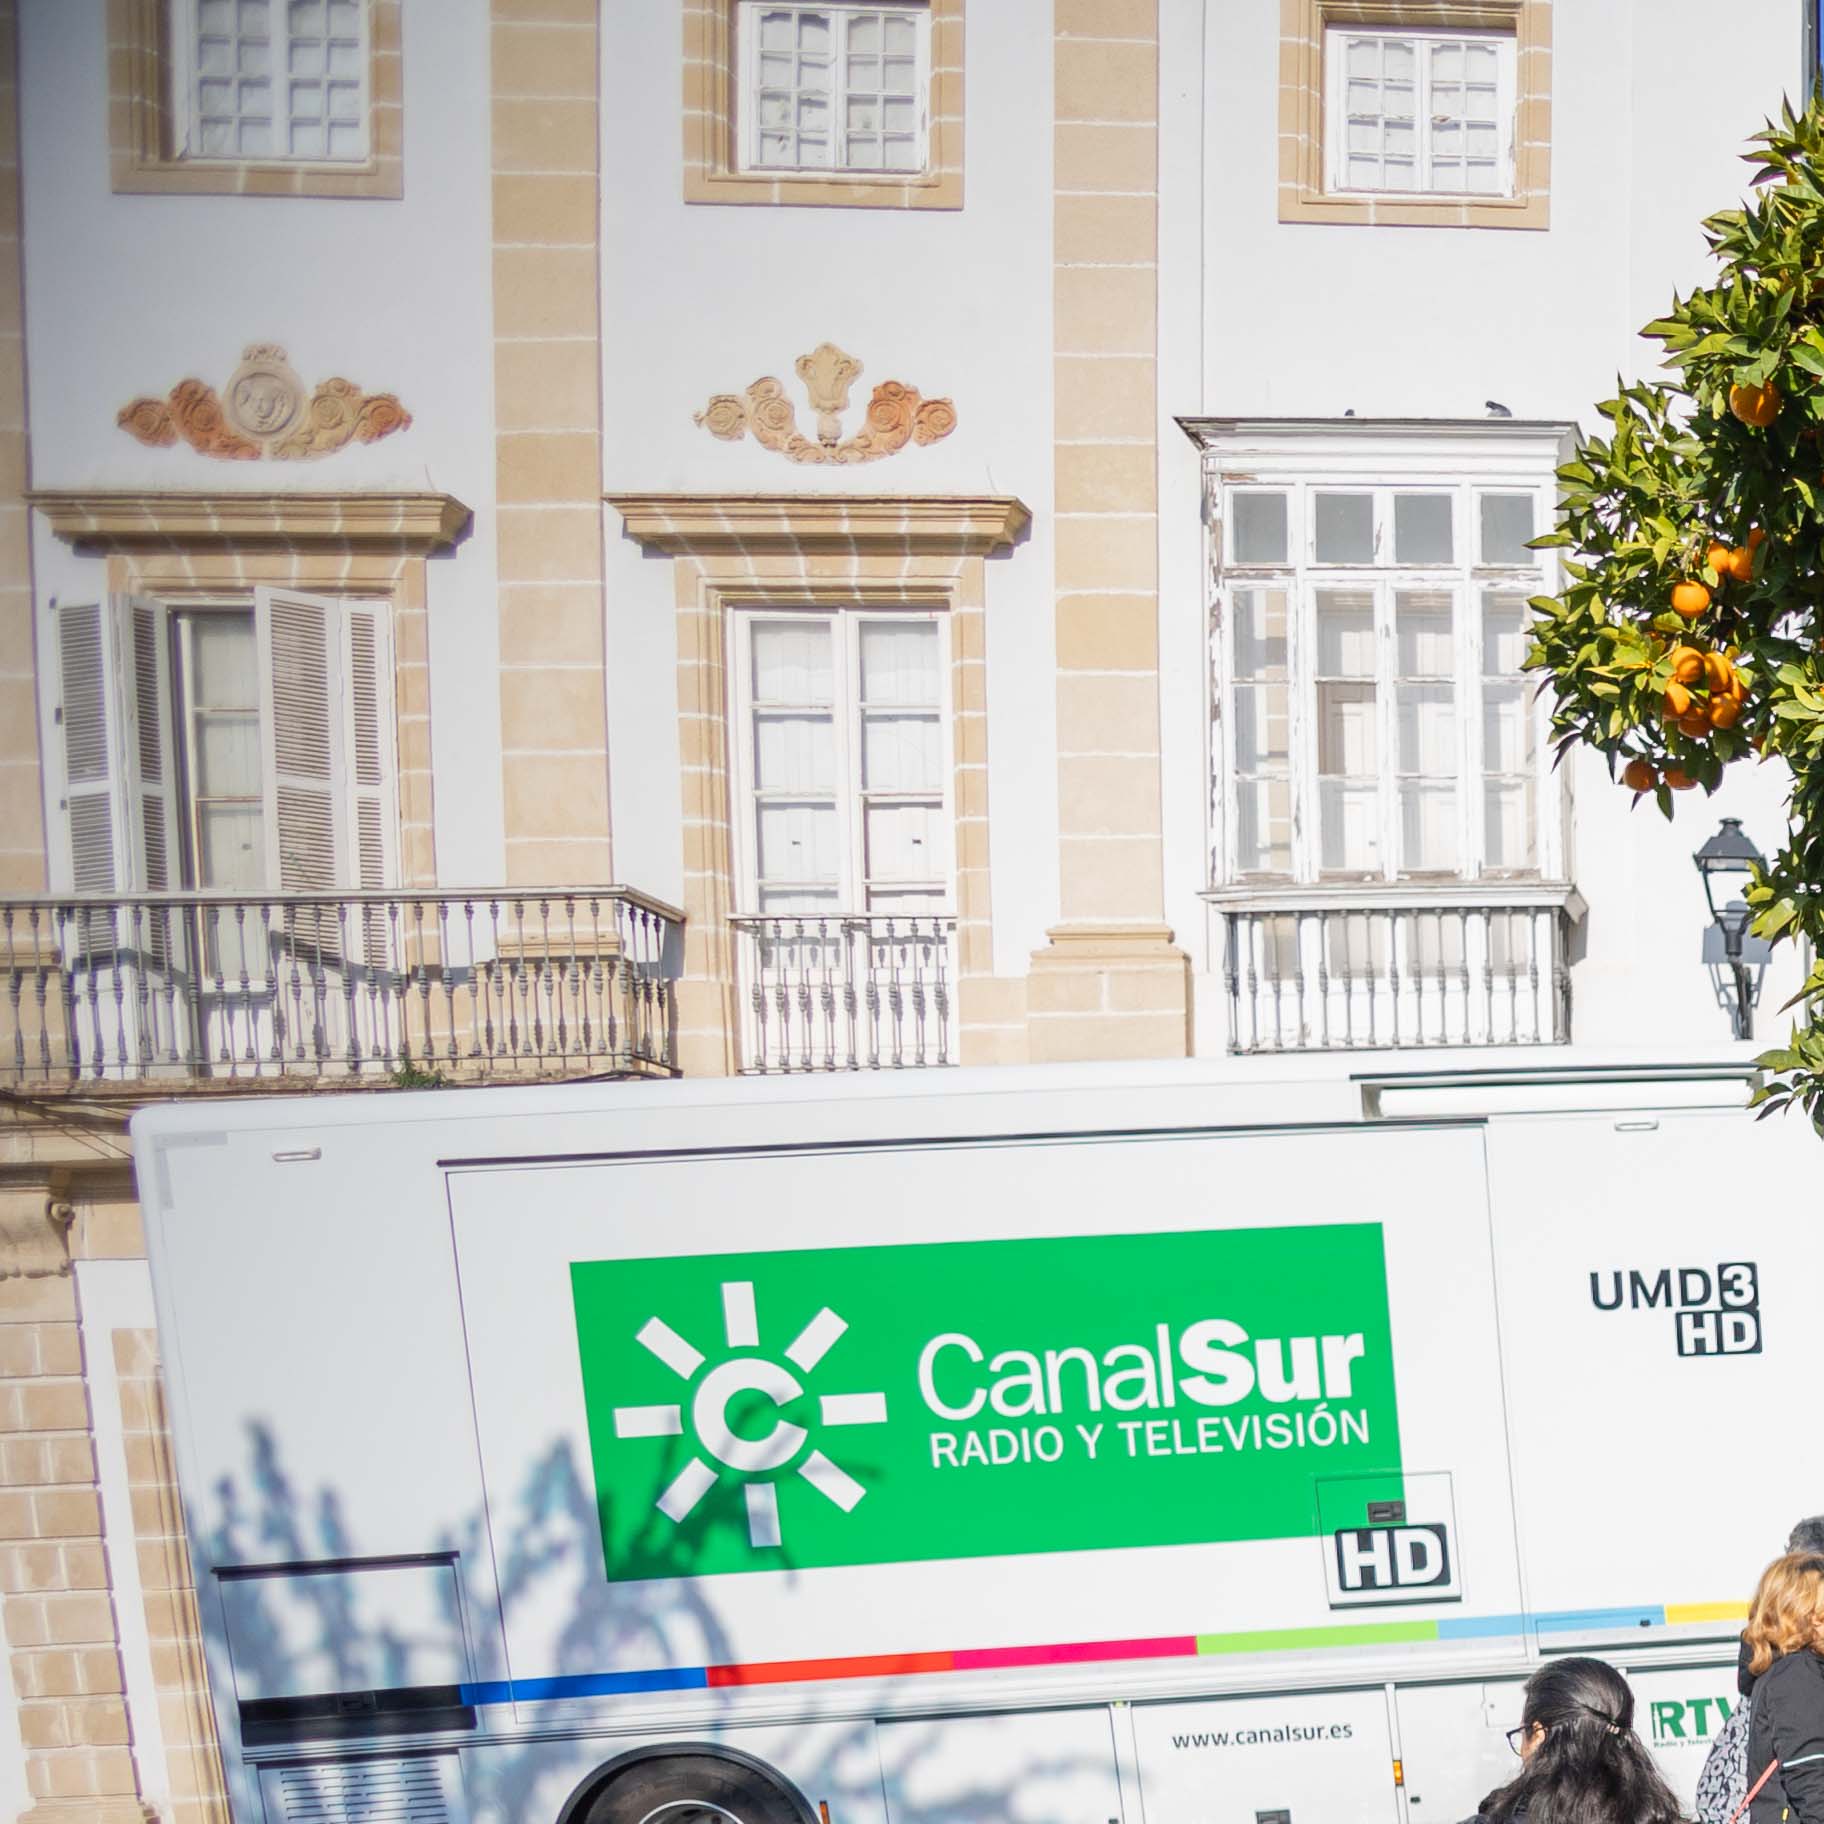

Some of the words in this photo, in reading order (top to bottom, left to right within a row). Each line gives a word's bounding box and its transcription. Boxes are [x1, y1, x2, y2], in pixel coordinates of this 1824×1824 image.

[1589, 1264, 1756, 1311] UMD3
[1680, 1311, 1759, 1355] HD
[917, 1318, 1366, 1421] CanalSur
[929, 1426, 1064, 1468] RADIO
[1076, 1423, 1104, 1459] Y
[1117, 1403, 1371, 1457] TELEVISIÓN
[1342, 1528, 1445, 1588] HD
[1172, 1721, 1353, 1749] www.canalsur.es
